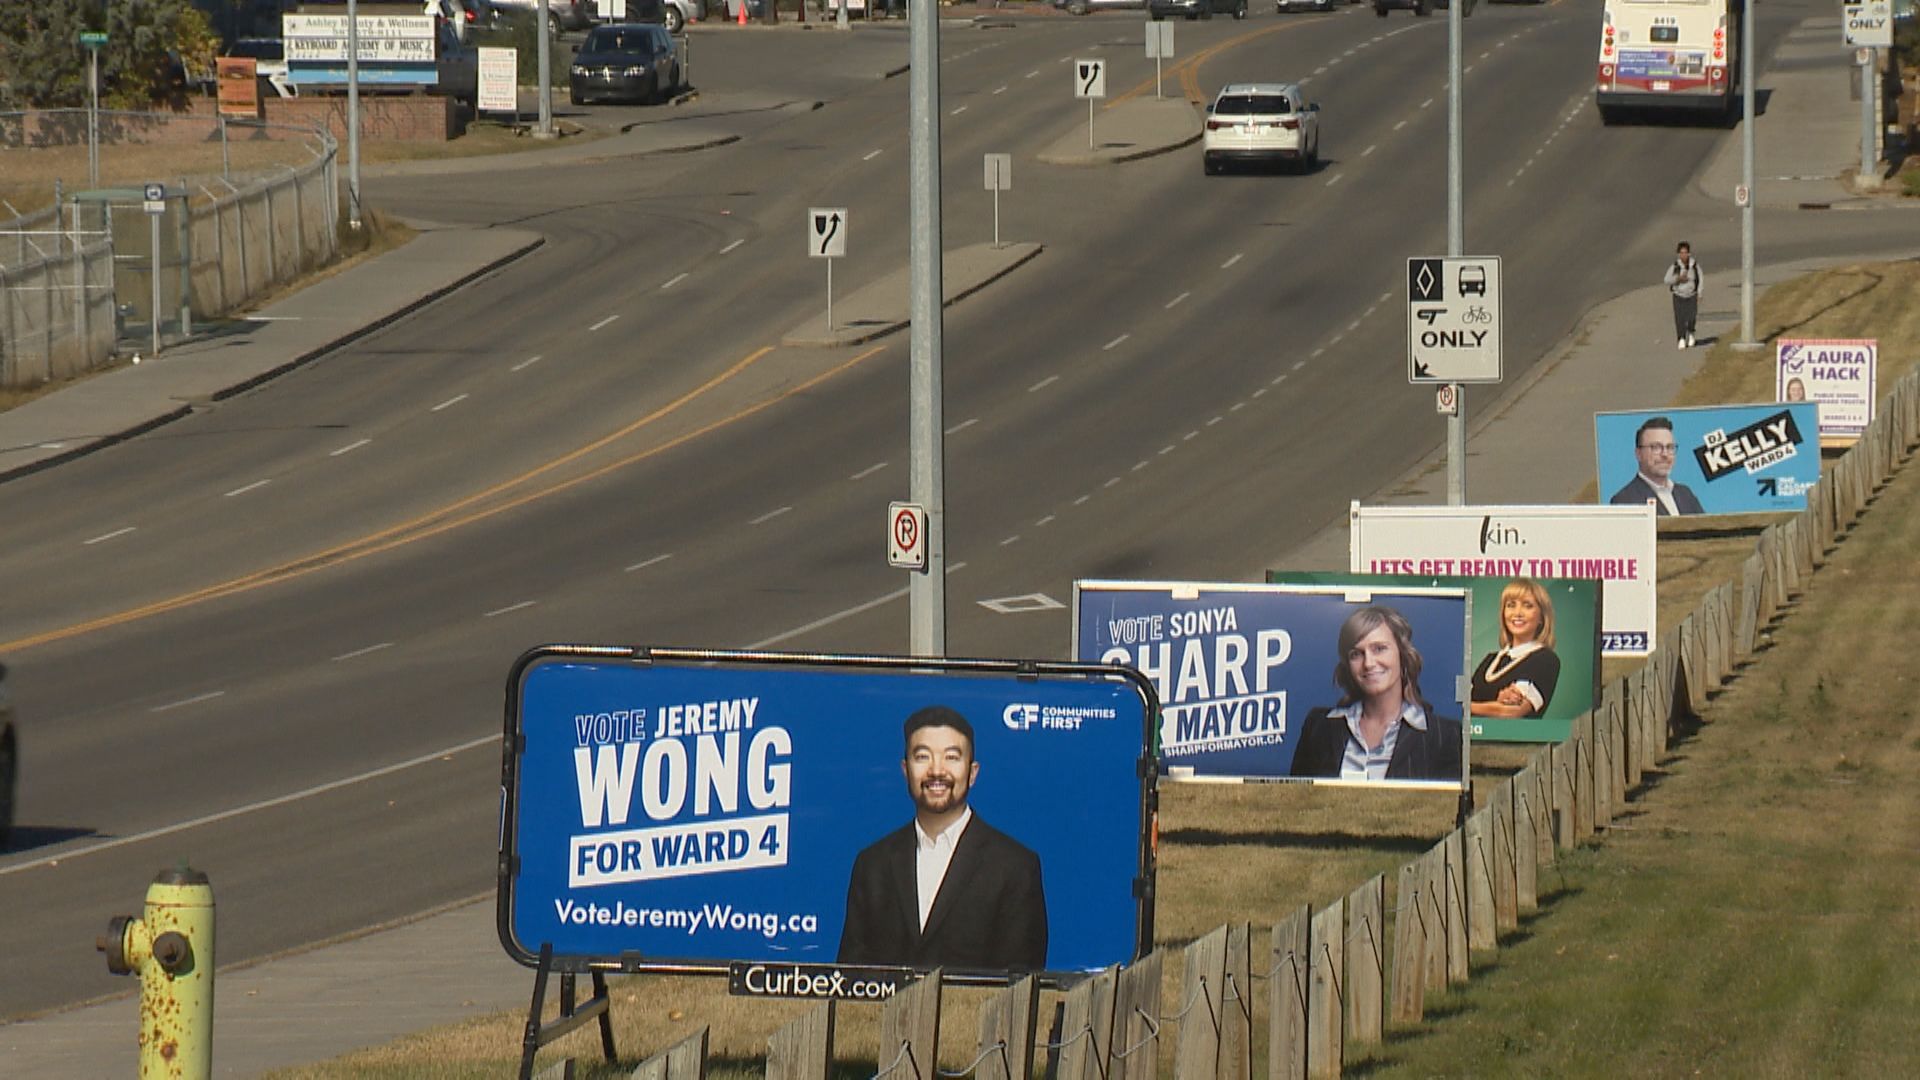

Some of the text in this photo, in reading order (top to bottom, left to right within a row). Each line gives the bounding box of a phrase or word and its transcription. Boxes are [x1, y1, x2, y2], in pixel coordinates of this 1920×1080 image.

[306, 18, 337, 28] Ashley
[388, 18, 430, 28] Wellness
[1850, 19, 1885, 28] ONLY
[295, 40, 337, 50] KEYBOARD
[384, 41, 395, 50] OF
[400, 40, 424, 51] MUSIC
[1421, 331, 1488, 347] ONLY
[1807, 351, 1866, 364] LAURA
[1812, 367, 1861, 380] HACK
[1704, 419, 1788, 473] KELLY
[1707, 431, 1723, 445] DJ
[1747, 448, 1793, 470] WARD 4
[1480, 515, 1527, 554] kin.
[1460, 559, 1523, 577] READY
[1528, 559, 1553, 578] TO
[1558, 559, 1638, 580] TUMBLE
[1109, 606, 1238, 646] VOTE SONYA
[1602, 634, 1643, 648] 7322
[575, 697, 759, 746] VOTE JEREMY
[1042, 706, 1116, 719] COMMUNITIES
[1042, 716, 1083, 729] FIRST
[1176, 697, 1281, 742] MAYOR
[1165, 734, 1284, 758] SHARPFORMAYOR.CA
[573, 726, 793, 828] WONG
[577, 825, 780, 876] FOR WARD 4
[555, 899, 818, 937] VoteJeremyWong.ca
